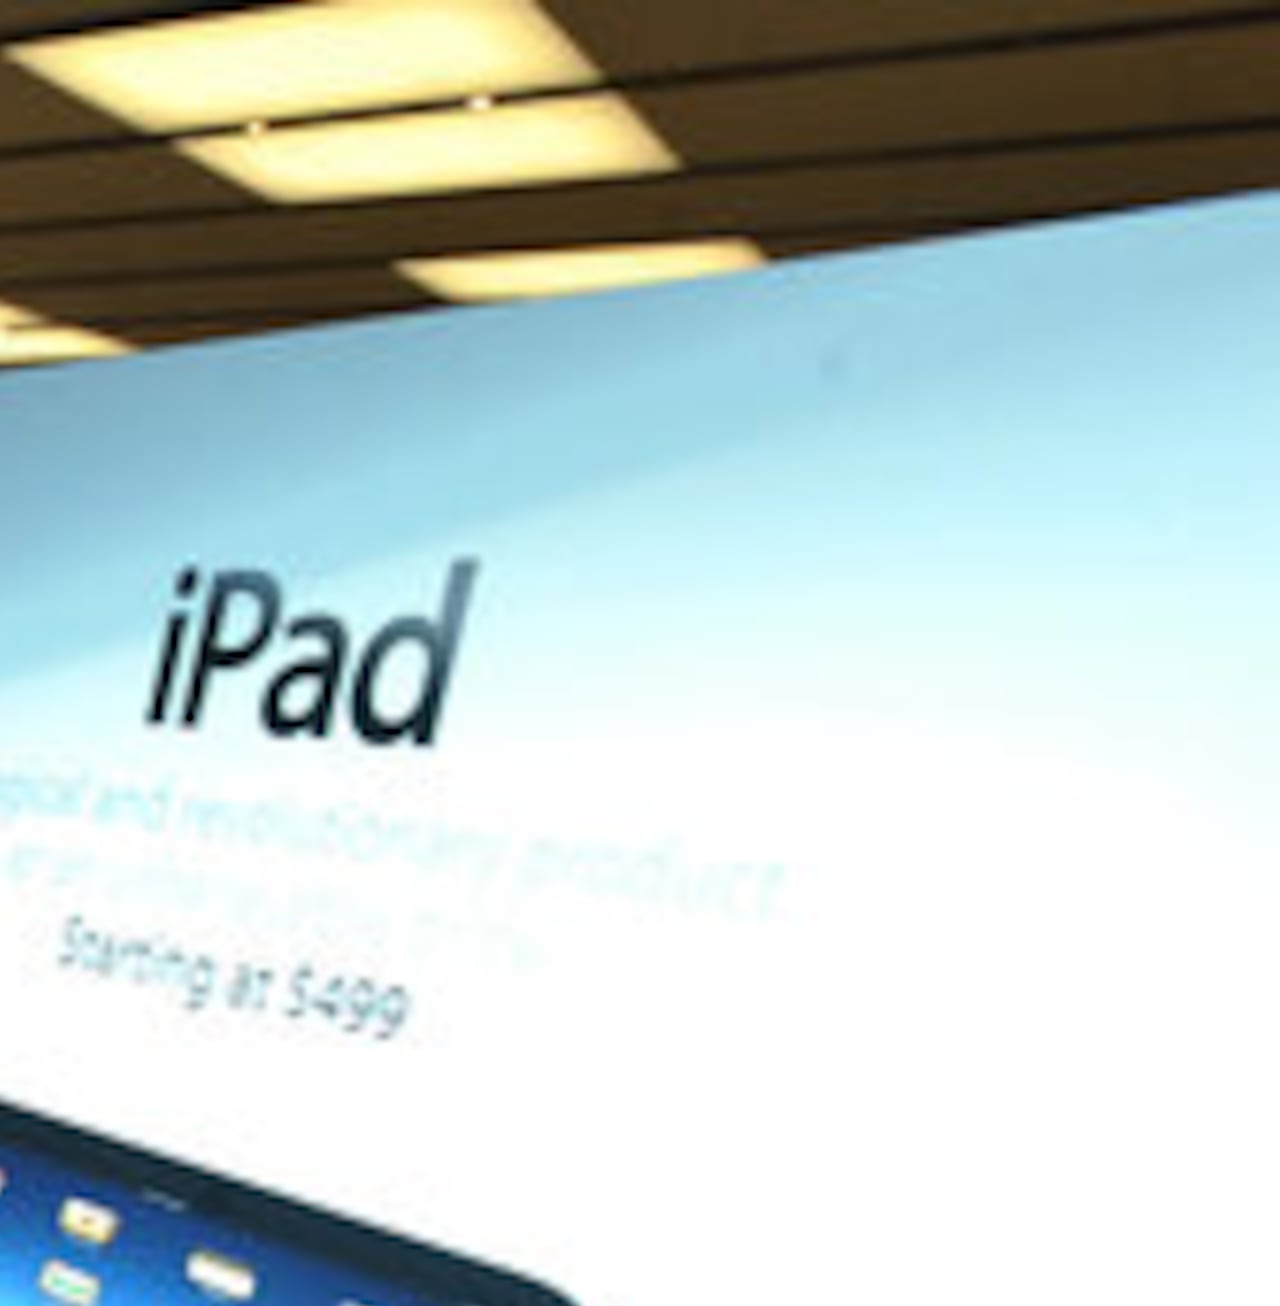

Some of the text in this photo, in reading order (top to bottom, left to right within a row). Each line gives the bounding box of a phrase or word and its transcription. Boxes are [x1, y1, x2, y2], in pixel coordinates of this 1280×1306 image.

[144, 554, 480, 748] iPad
[92, 775, 174, 832] and
[56, 914, 216, 1012] Starting
[228, 958, 276, 1012] at
